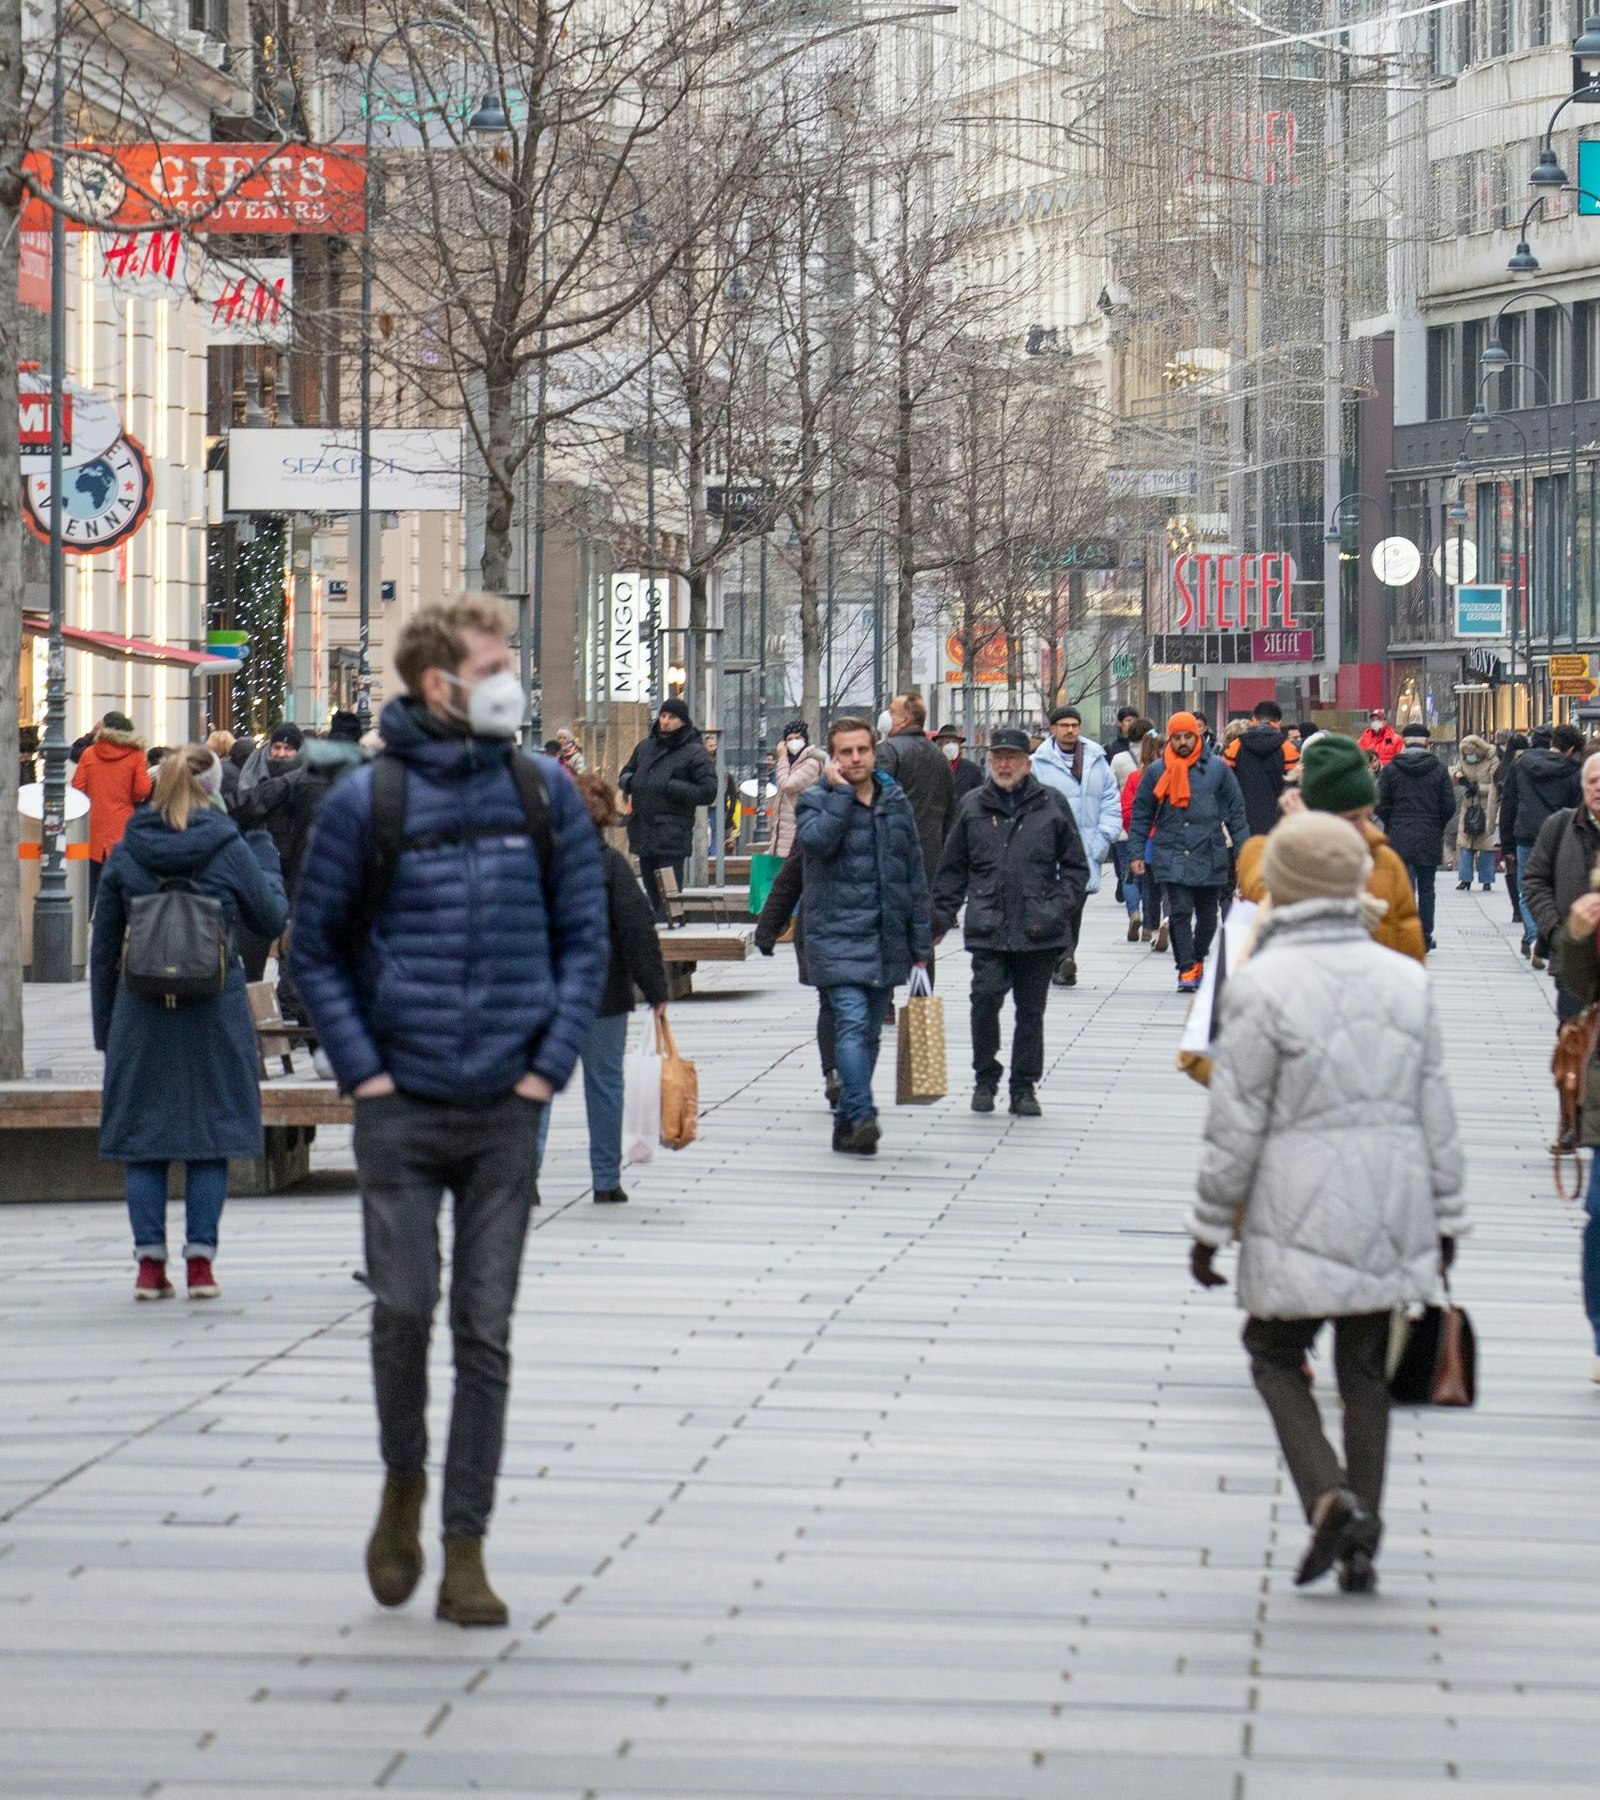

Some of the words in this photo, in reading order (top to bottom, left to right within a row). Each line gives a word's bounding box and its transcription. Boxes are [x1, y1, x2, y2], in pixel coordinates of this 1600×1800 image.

[149, 154, 327, 199] GIFTS
[176, 199, 327, 221] SOUVENIRS
[102, 231, 182, 280] H&M
[212, 275, 286, 326] H&M
[282, 457, 406, 474] SEACRT
[39, 494, 135, 540] VENNA
[1174, 551, 1300, 628] STEFFL
[614, 581, 633, 692] MANGO
[1264, 632, 1301, 654] STEFFL
